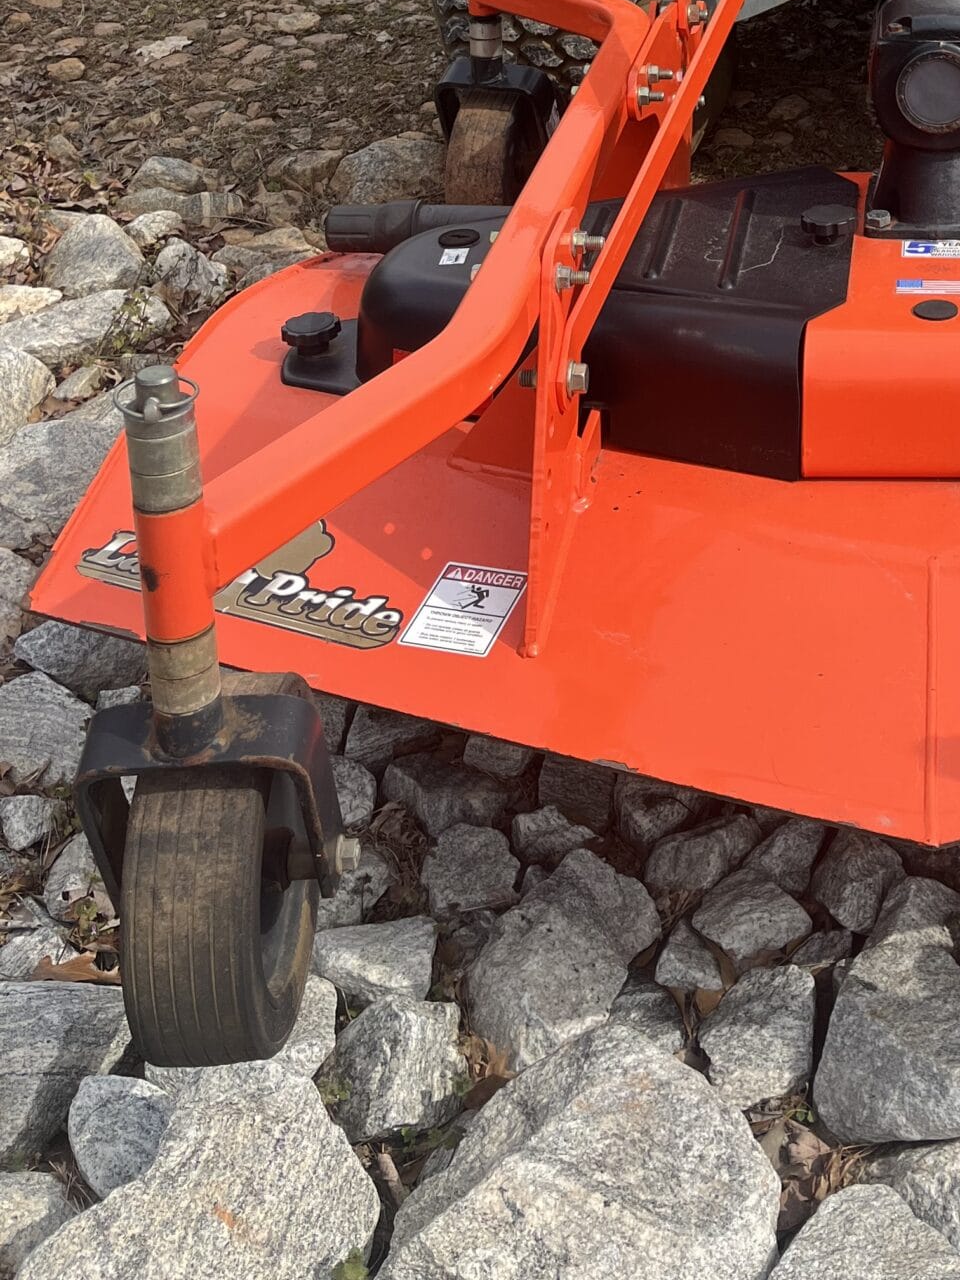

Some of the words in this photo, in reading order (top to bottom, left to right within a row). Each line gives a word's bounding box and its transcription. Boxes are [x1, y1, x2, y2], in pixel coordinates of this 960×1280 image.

[905, 240, 939, 255] 5
[463, 568, 524, 589] DANGER
[244, 571, 403, 635] Pride
